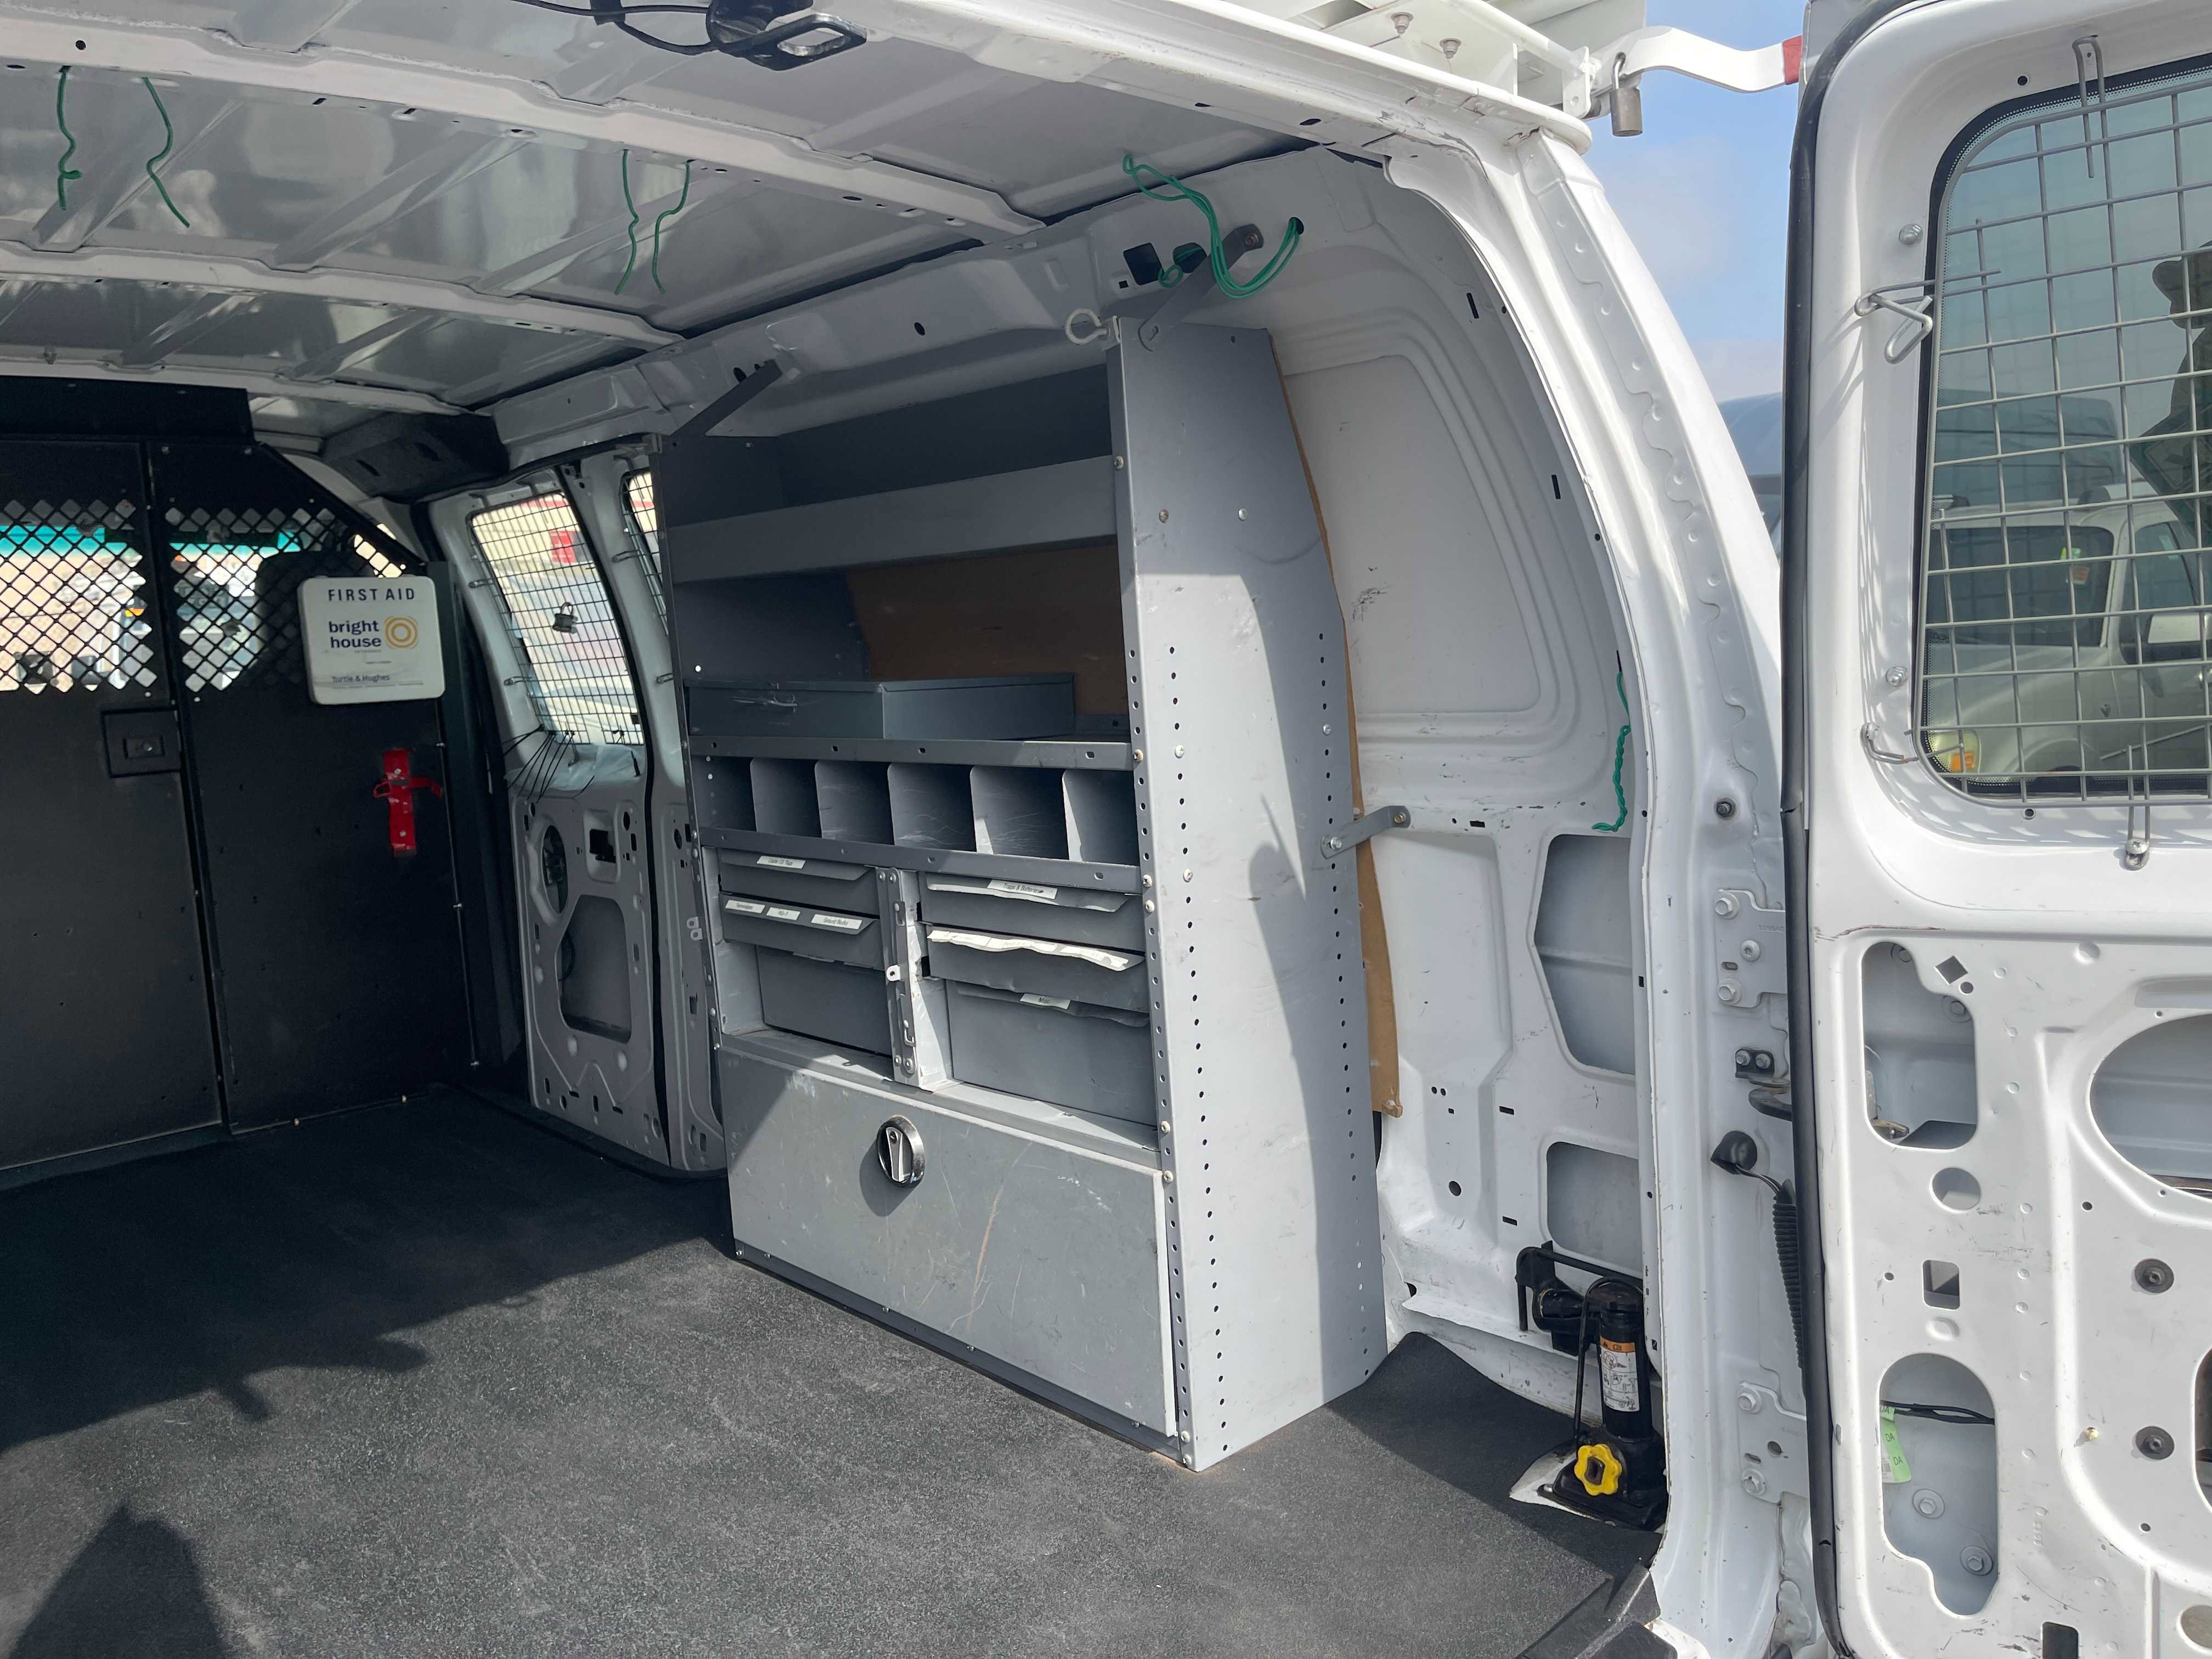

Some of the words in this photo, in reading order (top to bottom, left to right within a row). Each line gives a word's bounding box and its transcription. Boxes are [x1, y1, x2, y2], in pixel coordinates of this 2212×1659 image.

[328, 589, 377, 601] FIRST
[385, 588, 415, 600] AID
[329, 620, 380, 635] bright
[330, 637, 381, 648] house
[1885, 1432, 1895, 1442] DA
[1893, 1457, 1904, 1465] DA
